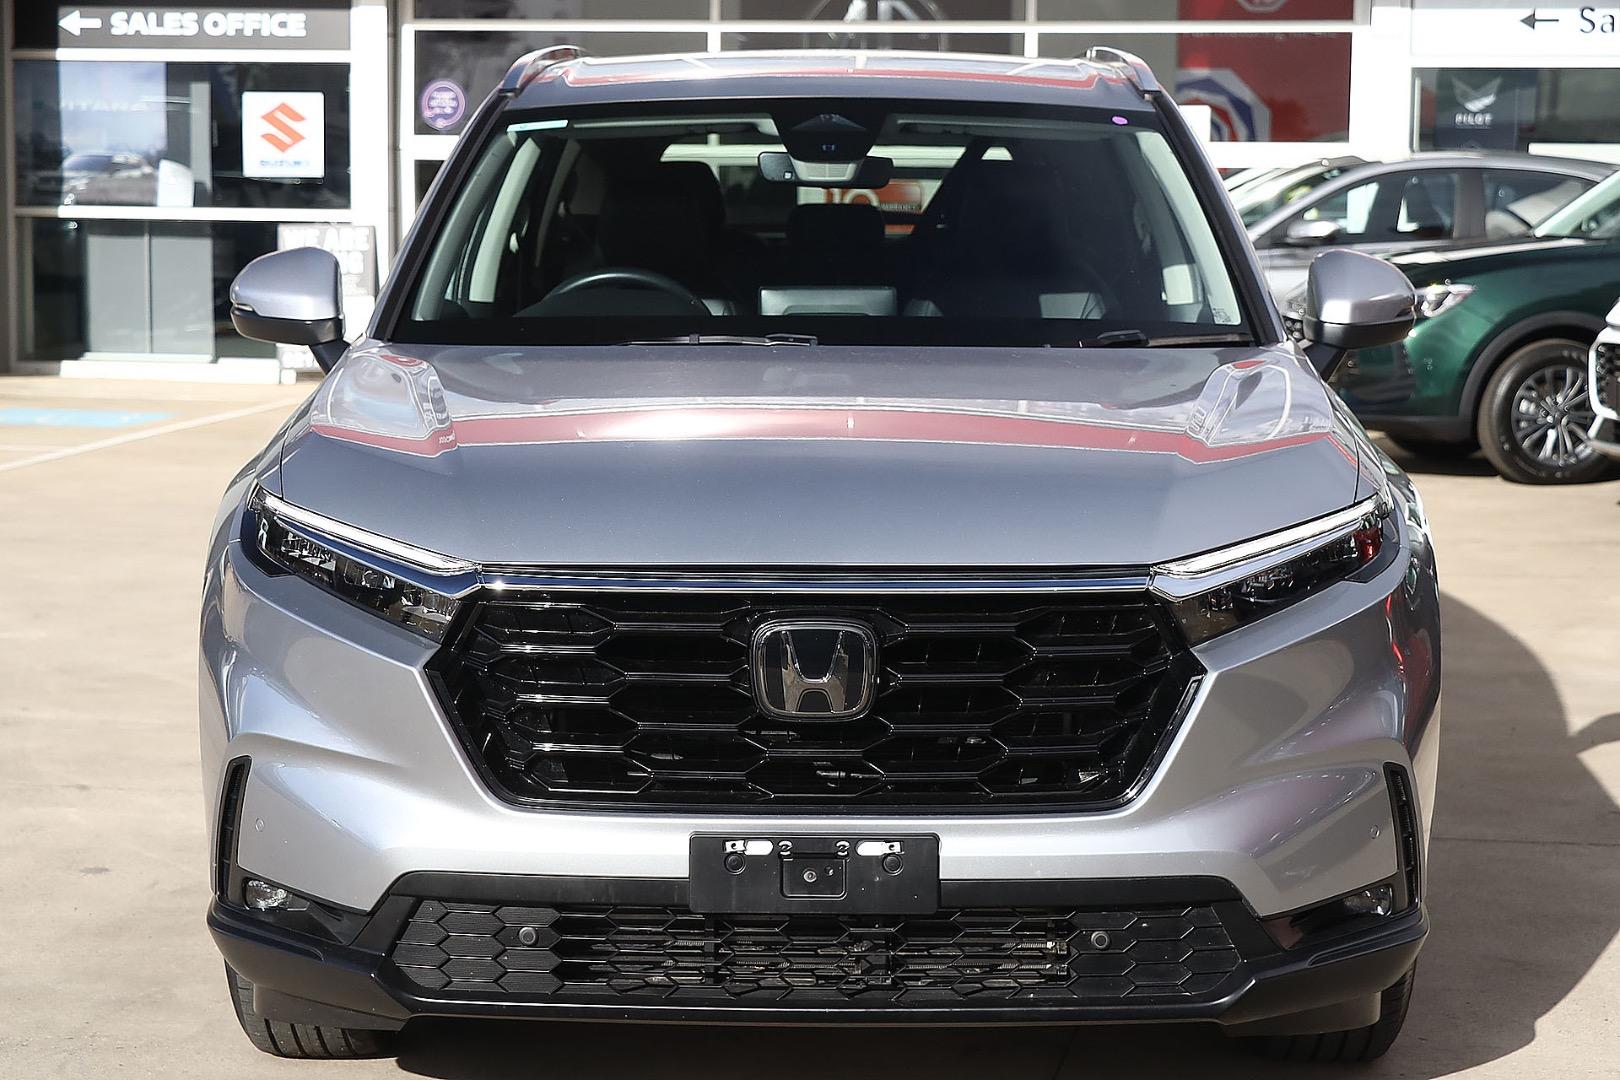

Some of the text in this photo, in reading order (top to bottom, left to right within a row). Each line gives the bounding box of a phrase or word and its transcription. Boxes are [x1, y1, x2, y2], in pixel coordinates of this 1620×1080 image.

[110, 11, 307, 38] SALES OFFICE
[1579, 6, 1615, 34] Sa
